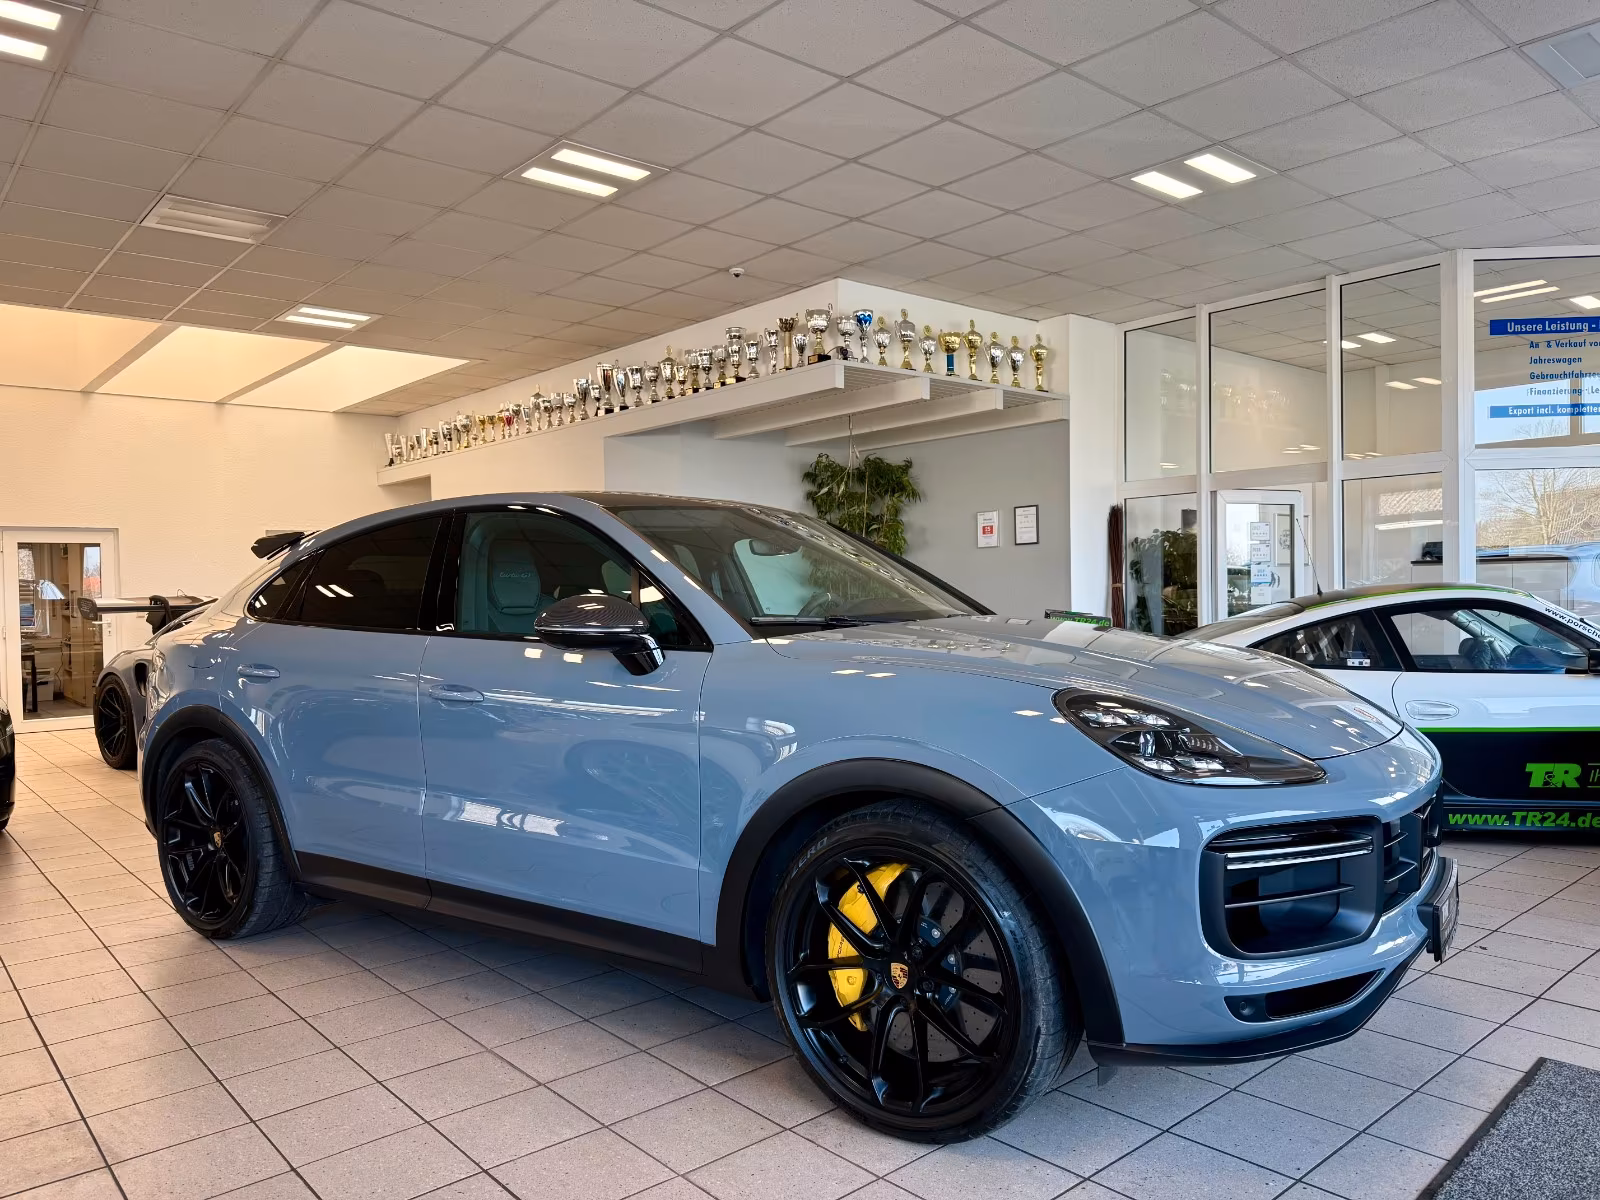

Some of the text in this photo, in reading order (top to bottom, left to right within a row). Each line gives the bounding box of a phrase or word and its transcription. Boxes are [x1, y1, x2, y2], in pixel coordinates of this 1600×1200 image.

[1507, 322, 1543, 332] Unsere
[1545, 321, 1589, 332] Leistung
[1555, 339, 1587, 348] Verkauf
[1529, 356, 1582, 365] Jahreswagen
[1530, 387, 1582, 396] Finanzierung
[1508, 407, 1534, 416] Export
[1536, 405, 1554, 414] incl.
[1448, 811, 1600, 828] www.TR24.de
